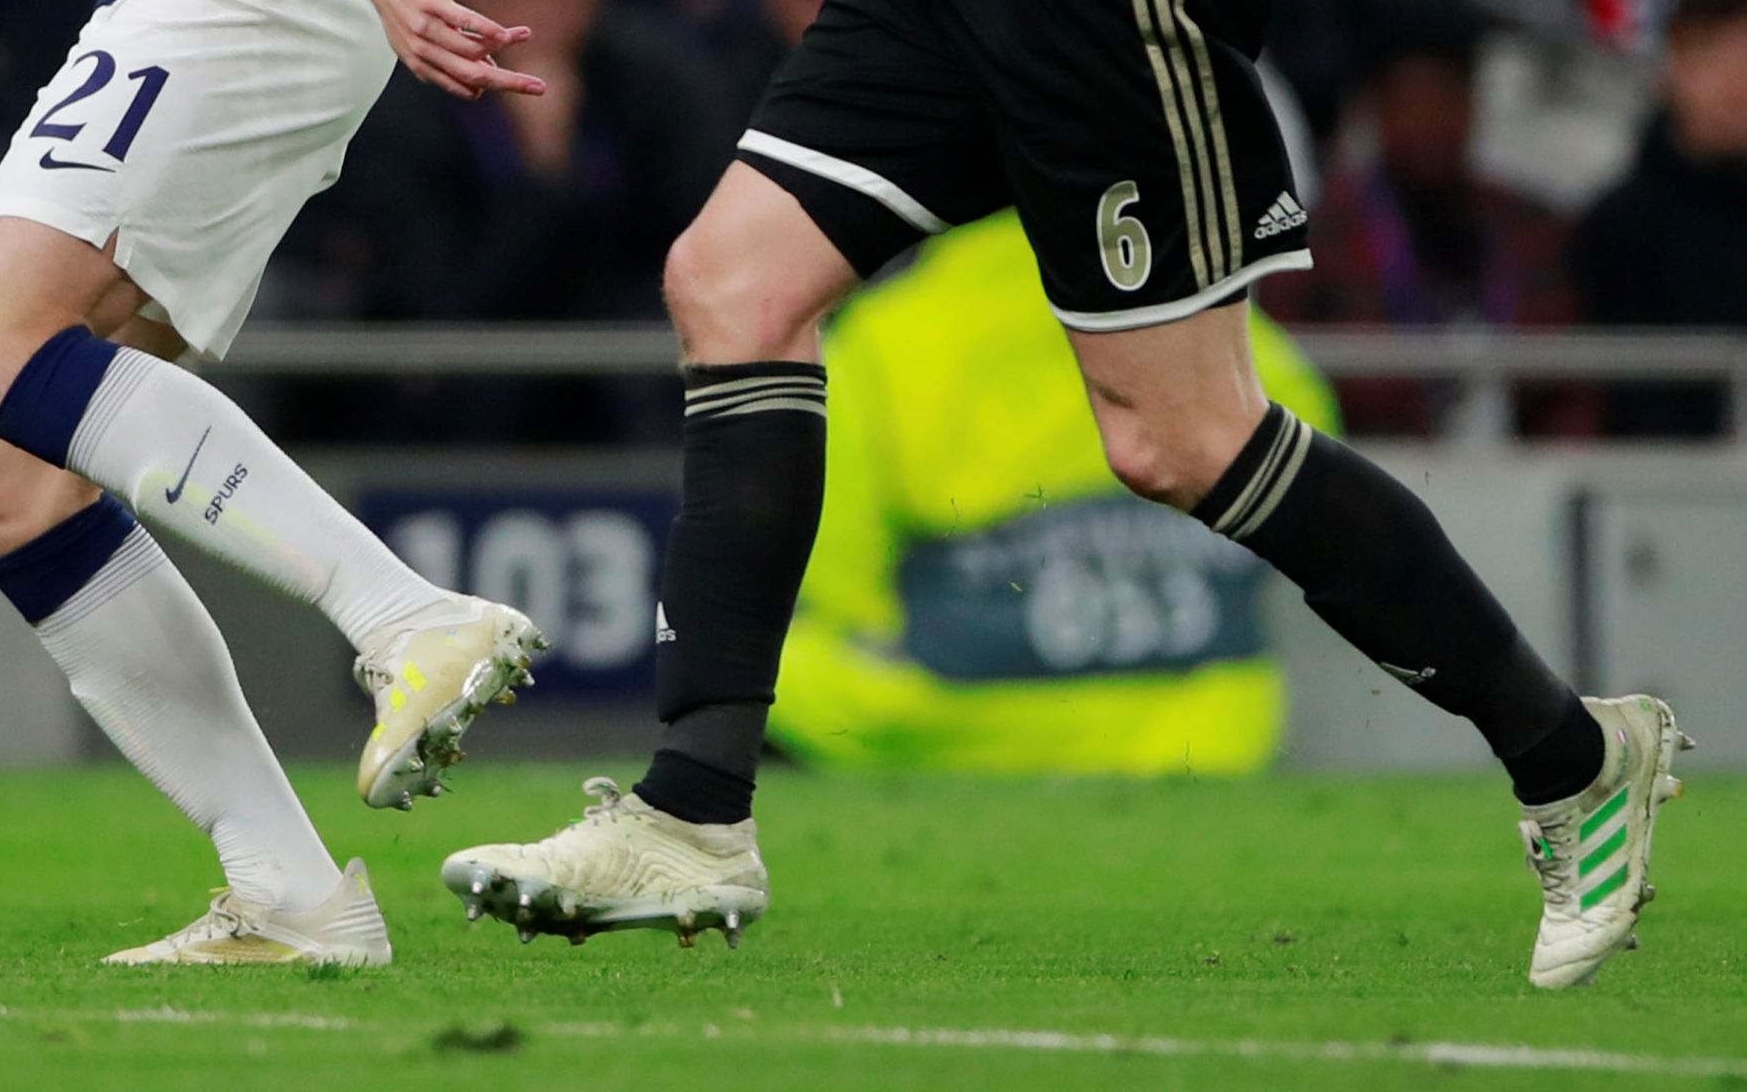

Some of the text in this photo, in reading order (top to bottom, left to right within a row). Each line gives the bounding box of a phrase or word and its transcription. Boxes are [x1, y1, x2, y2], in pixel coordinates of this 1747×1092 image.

[29, 49, 171, 164] 21
[1096, 180, 1152, 292] 6
[1254, 209, 1308, 239] adidas
[204, 462, 248, 526] SPURS
[395, 510, 650, 668] 103
